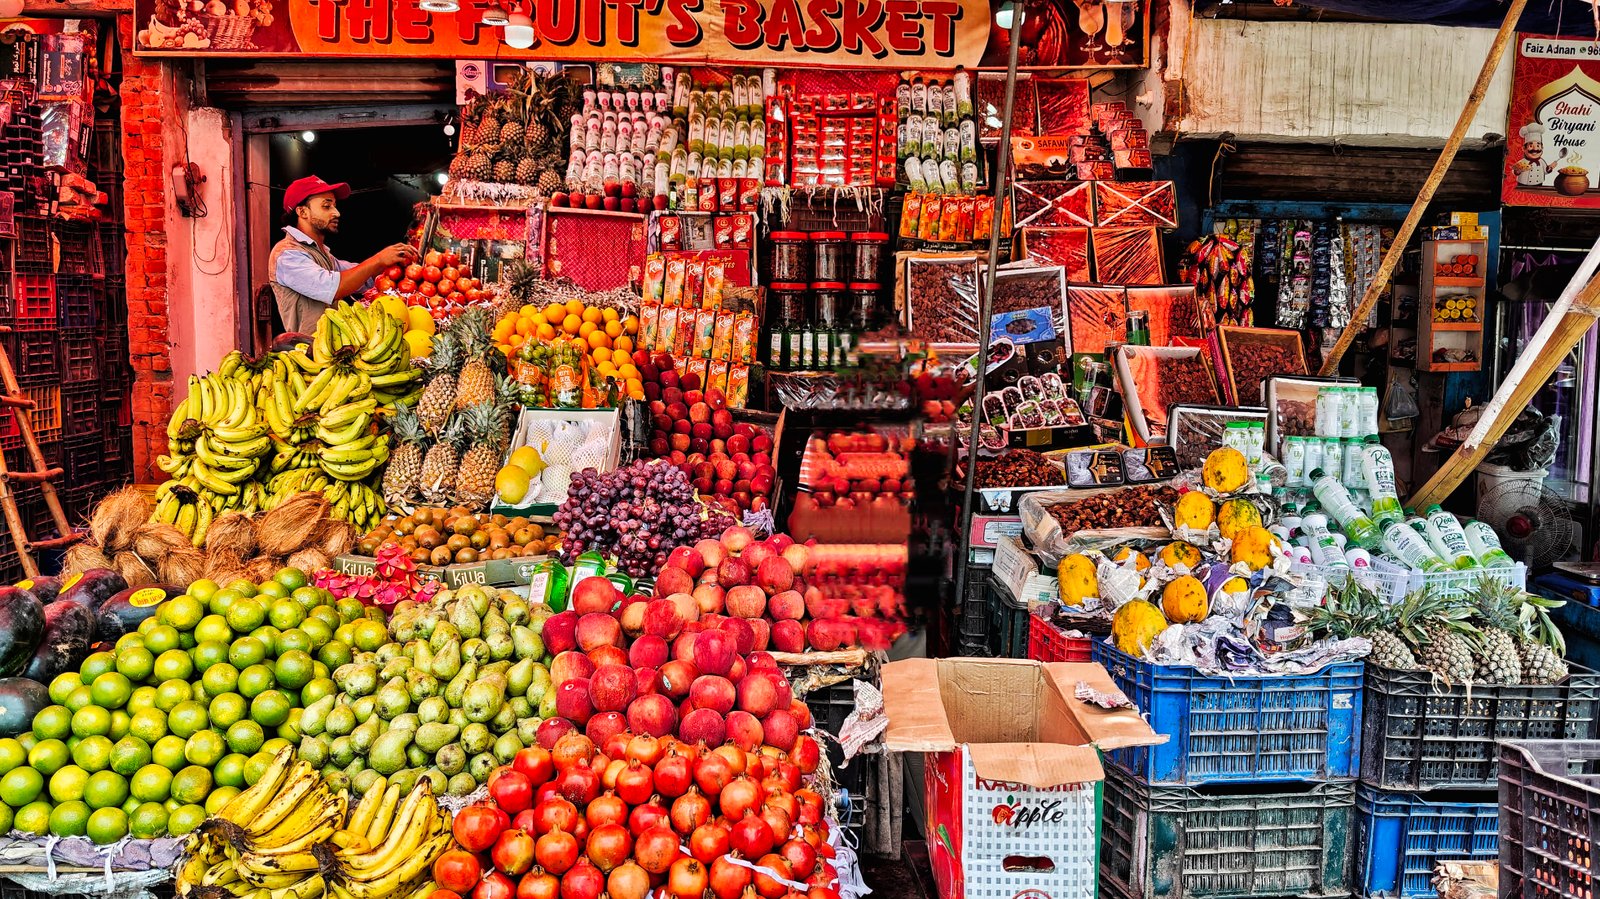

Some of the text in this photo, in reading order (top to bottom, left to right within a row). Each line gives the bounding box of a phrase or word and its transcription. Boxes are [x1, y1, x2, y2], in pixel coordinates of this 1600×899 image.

[316, 0, 433, 43] THE
[720, 0, 962, 57] BASKET
[1525, 42, 1600, 56] Faiz Adnan 96
[1554, 101, 1592, 116] Shahi
[1548, 116, 1596, 136] Biryani
[1553, 134, 1586, 148] House
